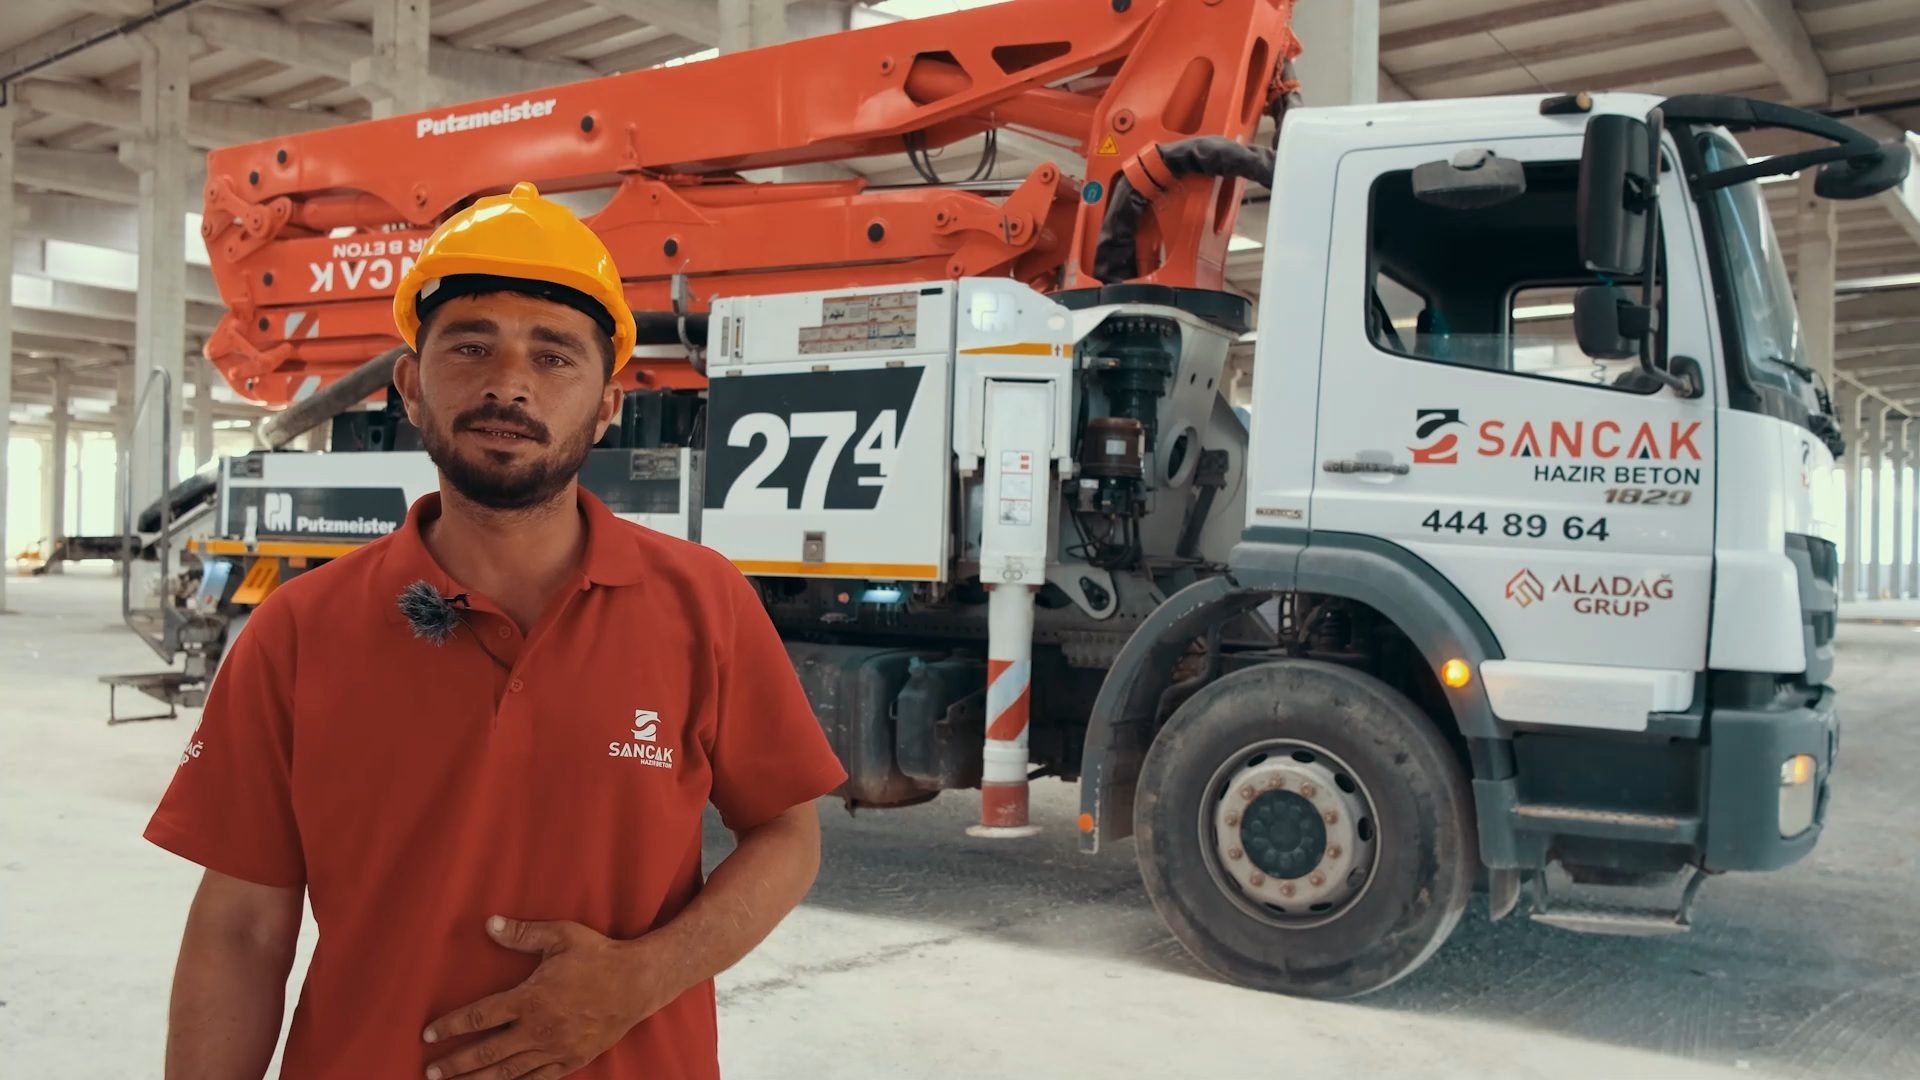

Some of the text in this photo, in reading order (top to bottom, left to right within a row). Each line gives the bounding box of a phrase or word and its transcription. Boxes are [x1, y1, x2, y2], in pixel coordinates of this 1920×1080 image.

[416, 98, 557, 139] Putzmeister
[1477, 420, 1703, 460] SANCAK
[1534, 464, 1701, 485] HAZIR BETON
[296, 516, 397, 535] Putzmeister
[1421, 509, 1610, 542] 444 89 64
[1552, 573, 1674, 600] ALADAĞ
[1573, 597, 1650, 618] GRUP
[608, 741, 674, 763] SANCAK
